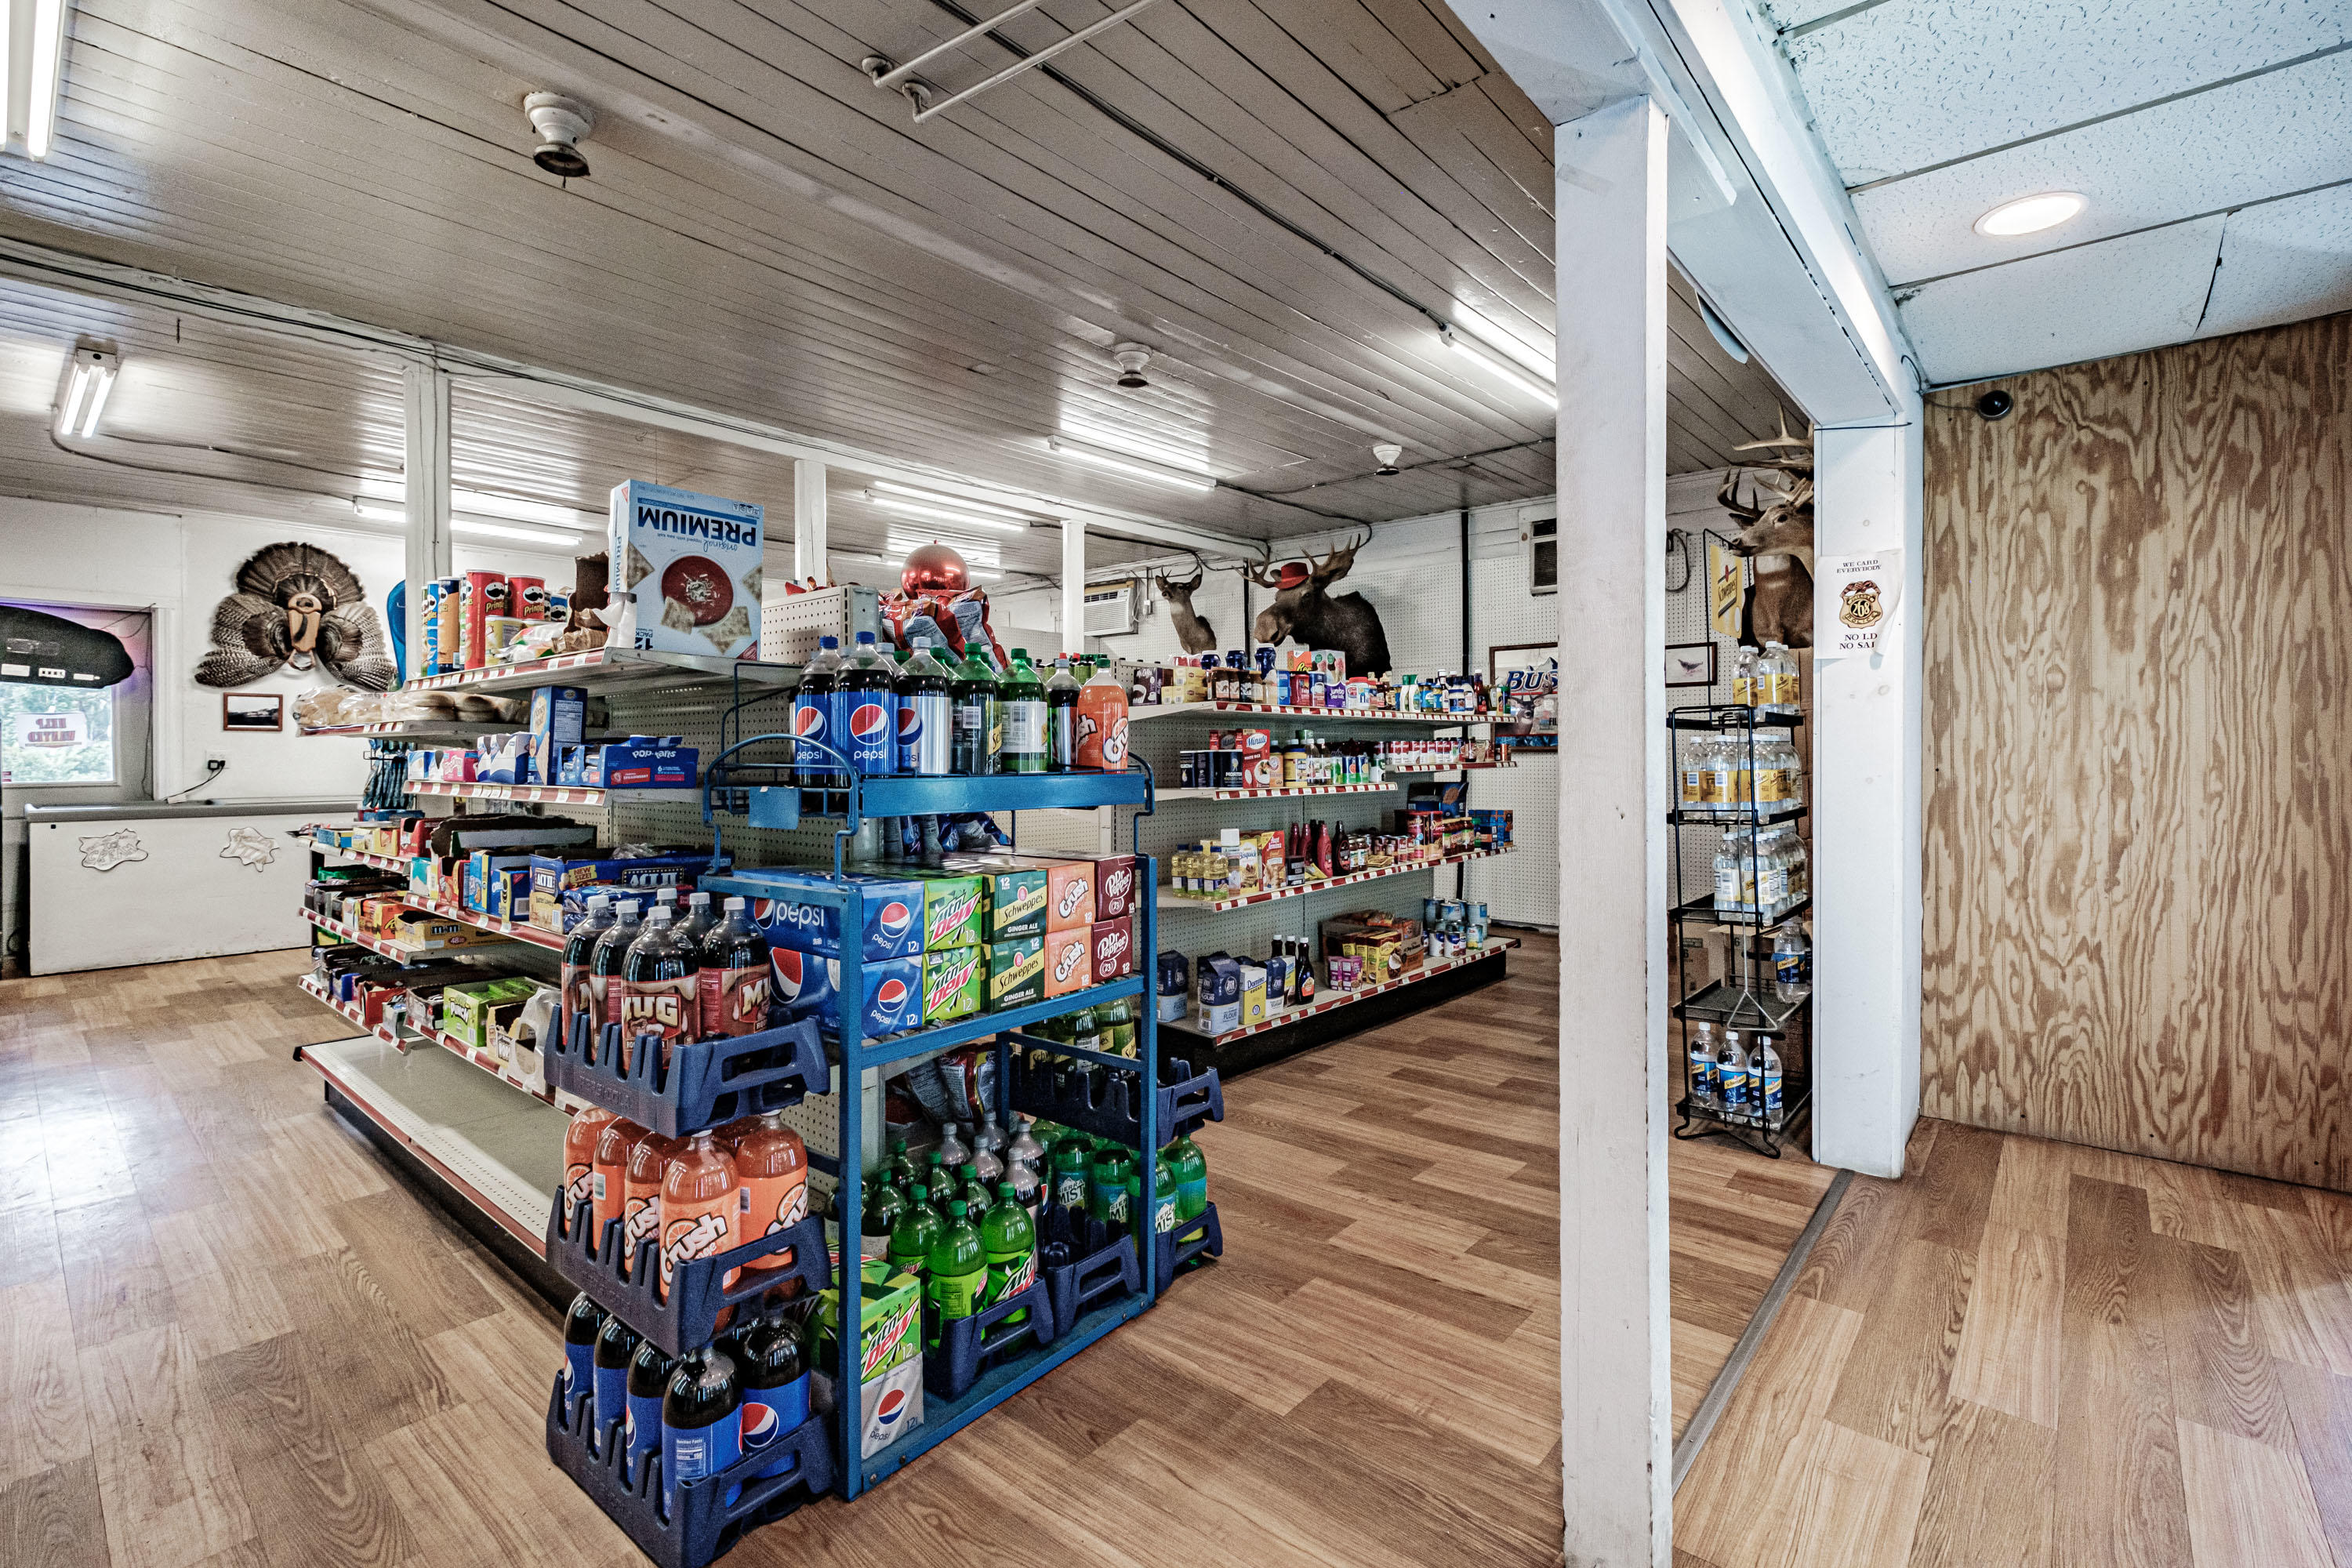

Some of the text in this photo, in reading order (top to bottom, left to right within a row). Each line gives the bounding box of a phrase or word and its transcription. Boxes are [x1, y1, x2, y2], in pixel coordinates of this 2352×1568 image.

[637, 506, 756, 547] PREMIUM
[702, 534, 738, 553] original
[1837, 564, 1882, 574] EVERYBODY
[1853, 600, 1870, 618] 268
[1845, 612, 1880, 624] POLICE
[1507, 670, 1558, 691] BUS
[1247, 736, 1267, 746] Minute
[797, 750, 822, 760] pepsi
[854, 750, 887, 760] pepsi
[573, 866, 590, 875] NEW
[1115, 869, 1125, 882] Dr
[537, 873, 546, 887] ACT
[1000, 877, 1011, 886] 12
[1109, 873, 1131, 898] Pepper
[1058, 877, 1090, 919] Crush
[1003, 892, 1044, 923] Schweppes
[1128, 902, 1134, 911] 12
[776, 902, 825, 930] pepsi
[932, 894, 981, 942] DEW
[1085, 912, 1092, 920] 12
[1007, 924, 1028, 933] GINGER
[871, 933, 895, 949] pepsi
[965, 929, 975, 943] 12
[1030, 938, 1040, 946] 12
[1109, 932, 1120, 945] Dr
[907, 941, 917, 953] 12
[1099, 934, 1127, 960] Pepper
[1054, 940, 1086, 982] Crush
[1123, 961, 1130, 971] 12
[999, 957, 1040, 993] Schweppes
[1081, 975, 1089, 983] 12
[929, 958, 978, 1011] DEW
[1247, 977, 1265, 989] Domino
[1004, 992, 1025, 1003] GINGER
[962, 999, 972, 1013] 12
[870, 1010, 893, 1025] pepsi
[906, 1014, 915, 1026] 12
[660, 1212, 728, 1286] Crush
[864, 1301, 918, 1374] DEW
[902, 1342, 913, 1360] 12
[906, 1417, 916, 1432] 12
[869, 1428, 891, 1444] pepsi
